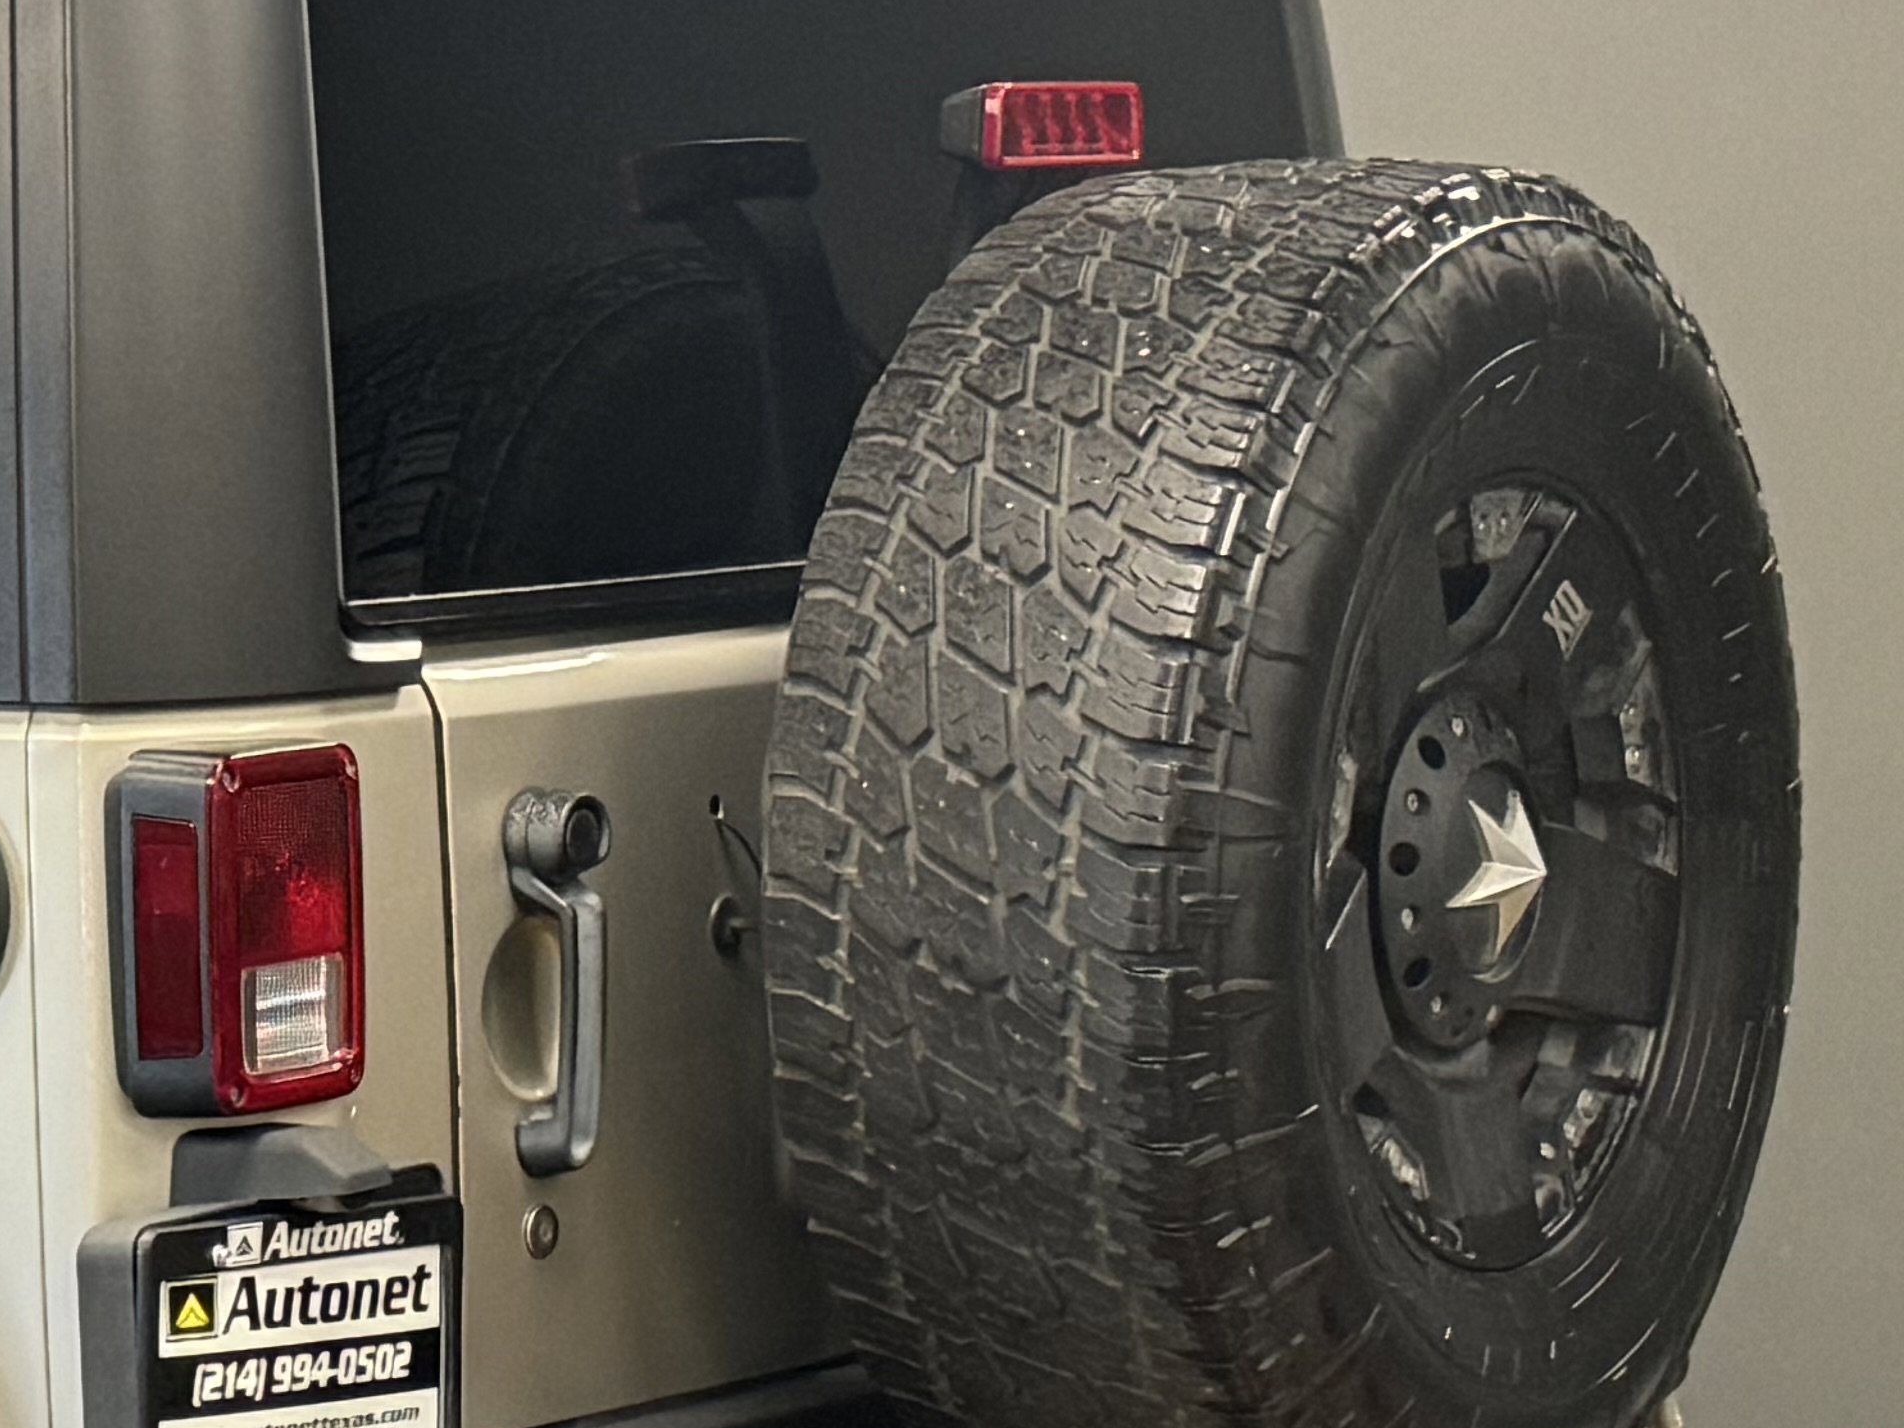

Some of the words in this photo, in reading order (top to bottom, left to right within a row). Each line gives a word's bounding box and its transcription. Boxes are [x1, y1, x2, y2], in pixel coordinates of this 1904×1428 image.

[223, 1264, 432, 1335] Autonet
[192, 1358, 267, 1408] (214)
[271, 1341, 413, 1394] 994-0502
